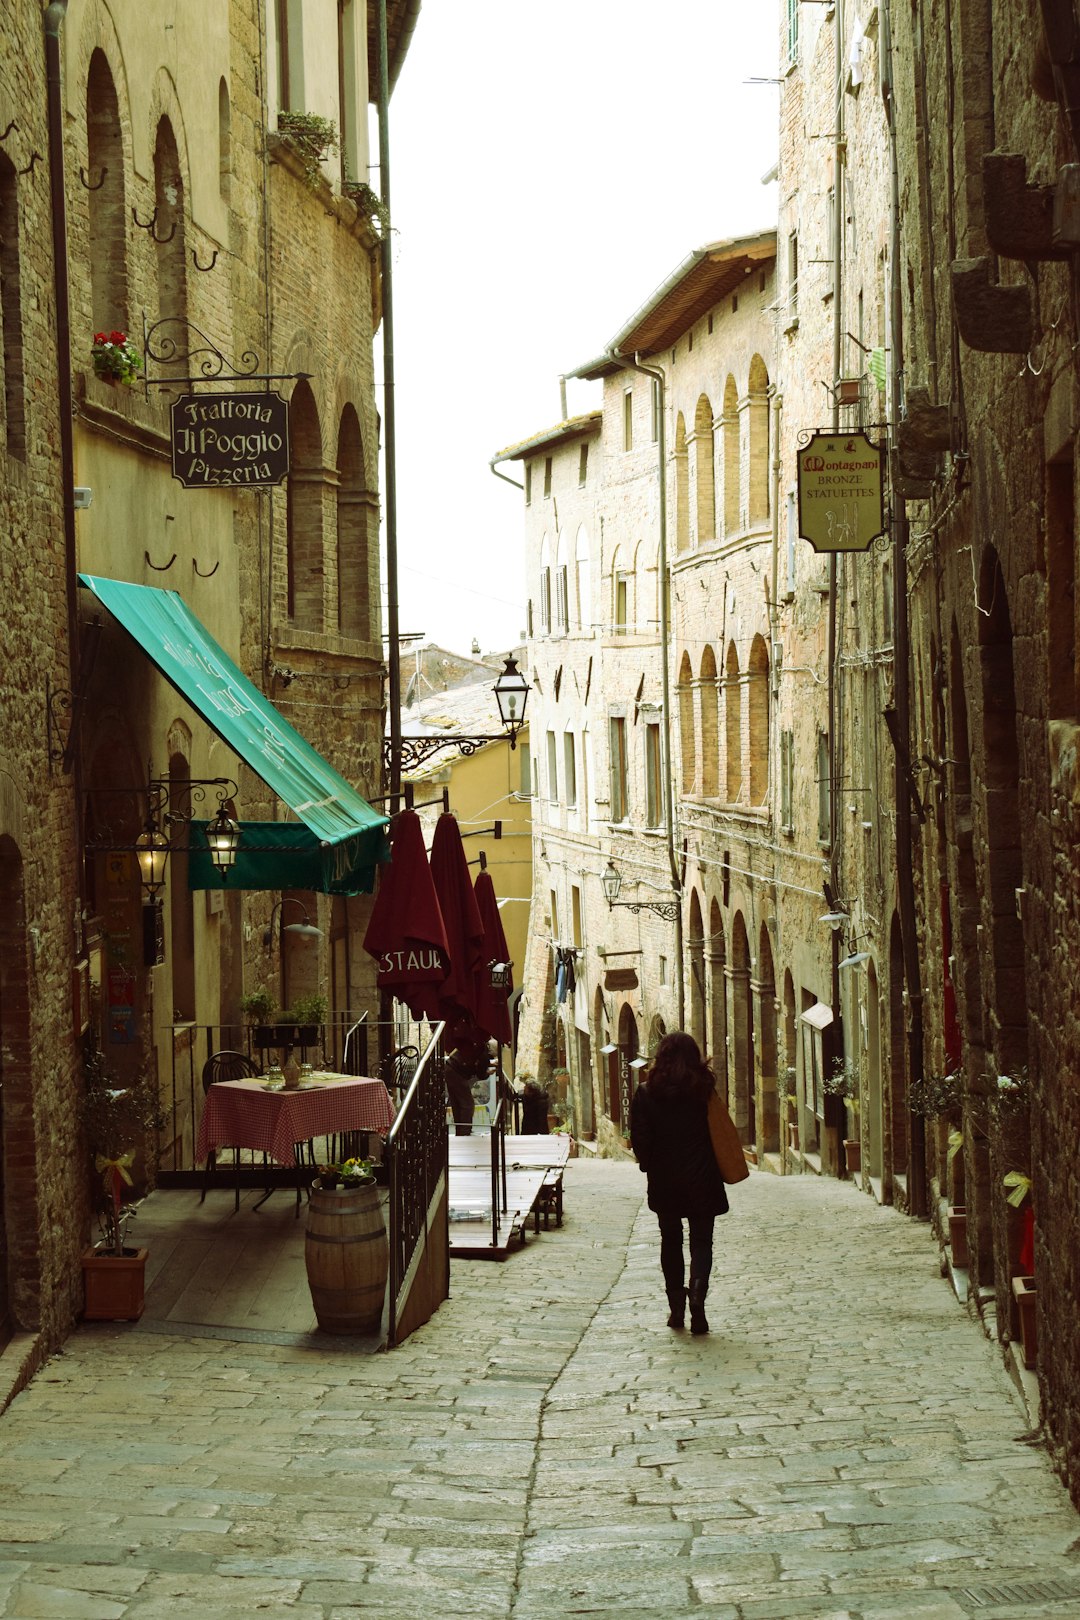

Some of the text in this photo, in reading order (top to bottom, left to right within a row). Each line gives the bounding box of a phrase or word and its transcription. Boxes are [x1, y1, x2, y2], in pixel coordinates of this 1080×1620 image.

[184, 400, 273, 426] Trattoria
[200, 427, 283, 461] Poggio
[187, 458, 272, 486] Pizzeria
[803, 456, 878, 472] Montagnani
[817, 475, 863, 485] BRONZE
[806, 488, 875, 499] STATUETTES
